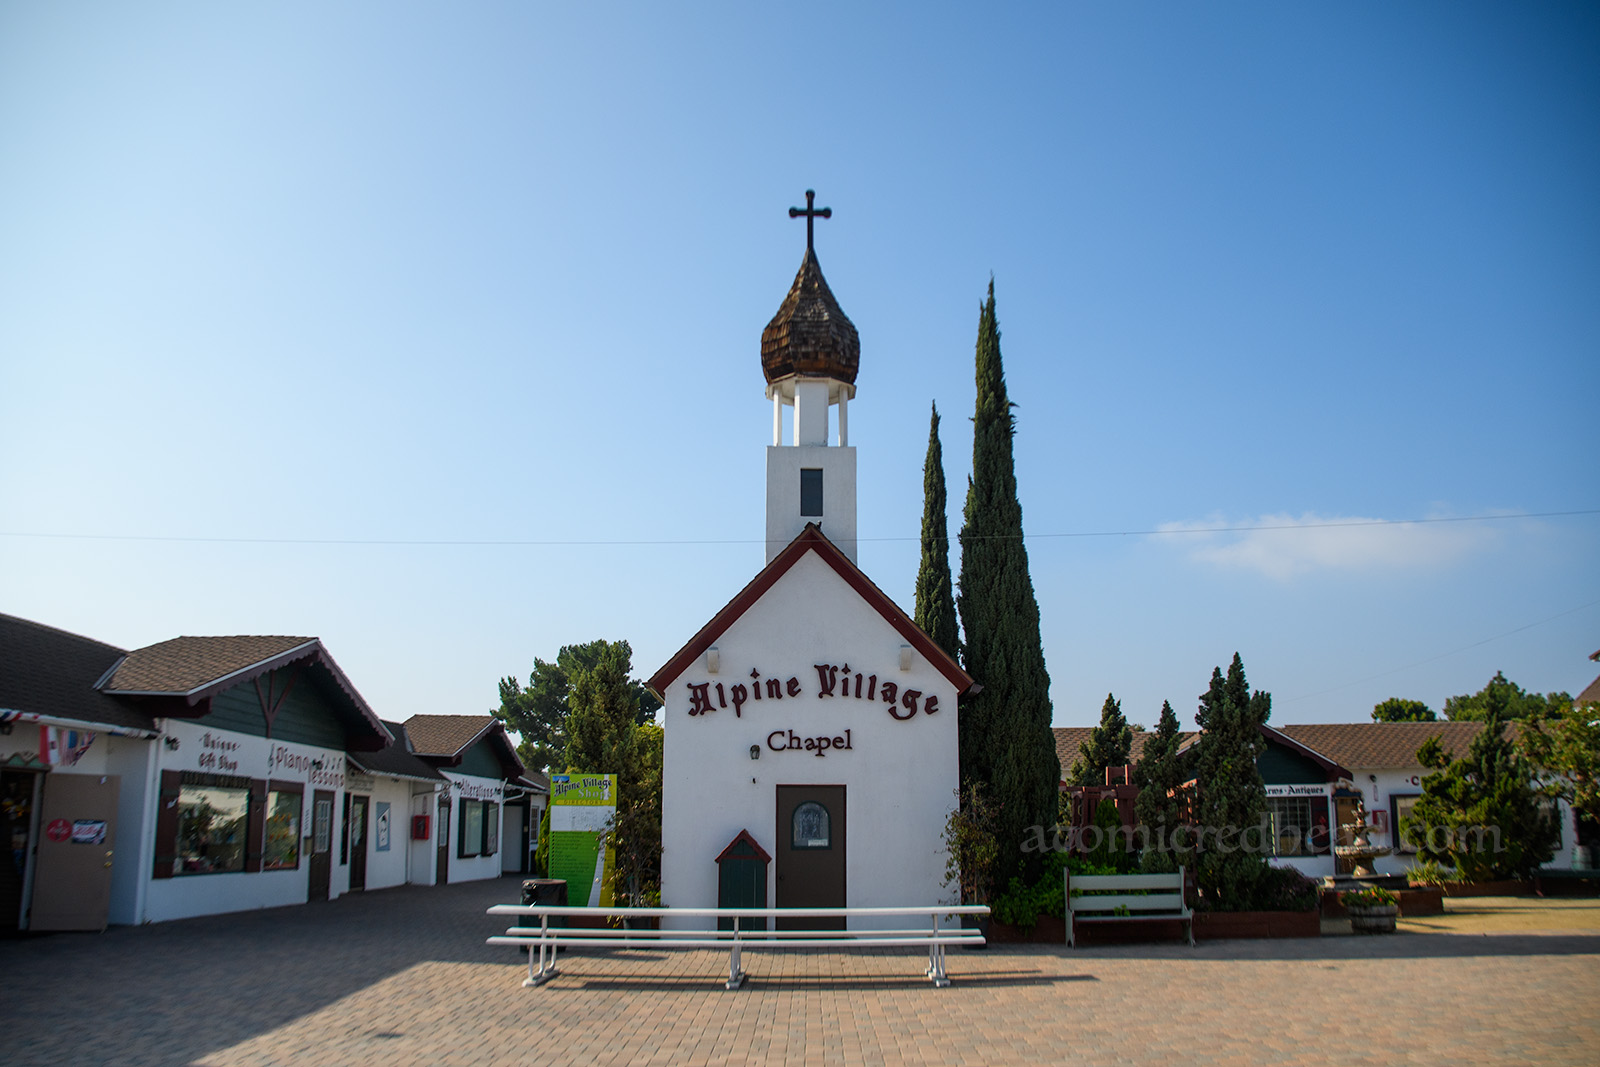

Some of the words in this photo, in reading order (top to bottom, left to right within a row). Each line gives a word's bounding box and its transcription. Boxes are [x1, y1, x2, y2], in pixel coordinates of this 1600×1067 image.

[687, 668, 801, 718] Alpine
[813, 663, 939, 720] Village
[767, 729, 852, 757] Chapel
[275, 746, 309, 773] Piano
[554, 780, 581, 797] Alpine
[582, 777, 612, 790] Village
[1287, 784, 1323, 795] Antiques
